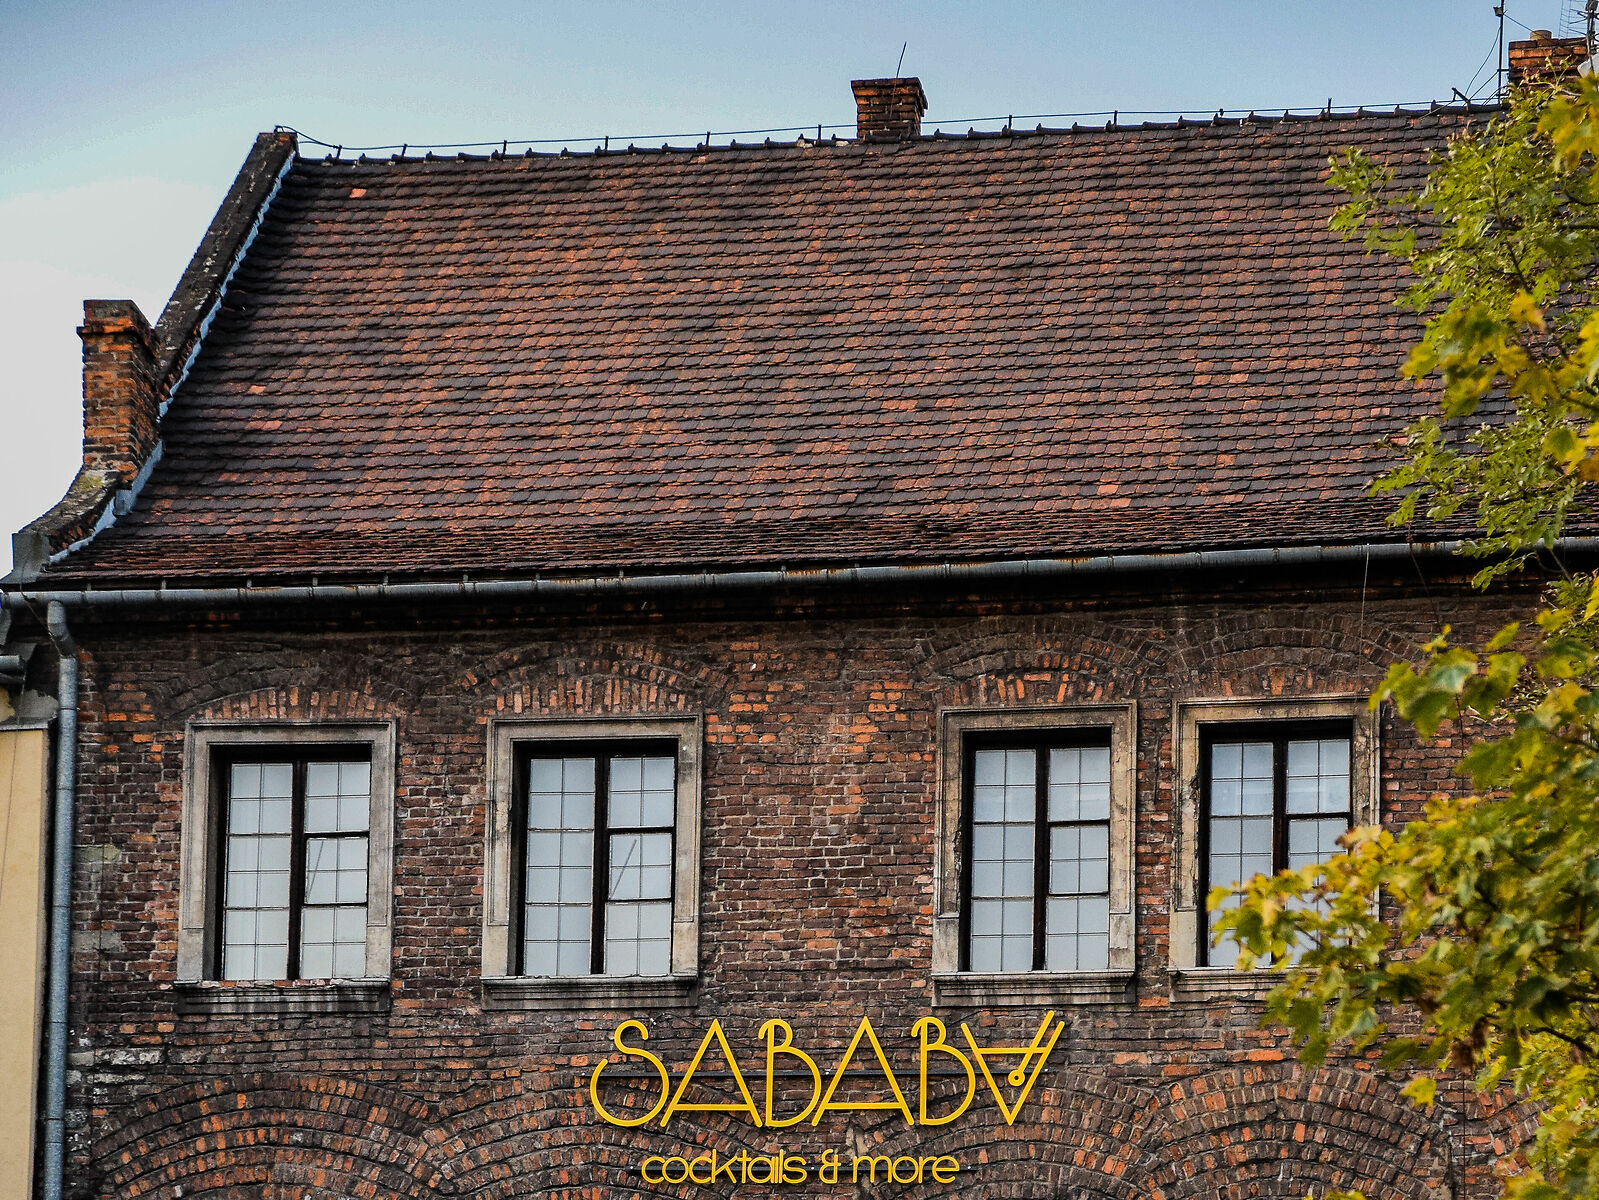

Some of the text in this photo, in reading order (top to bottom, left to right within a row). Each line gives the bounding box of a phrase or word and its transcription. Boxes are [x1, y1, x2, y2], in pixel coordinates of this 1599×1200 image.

[641, 1148, 960, 1184] cocktails & more
